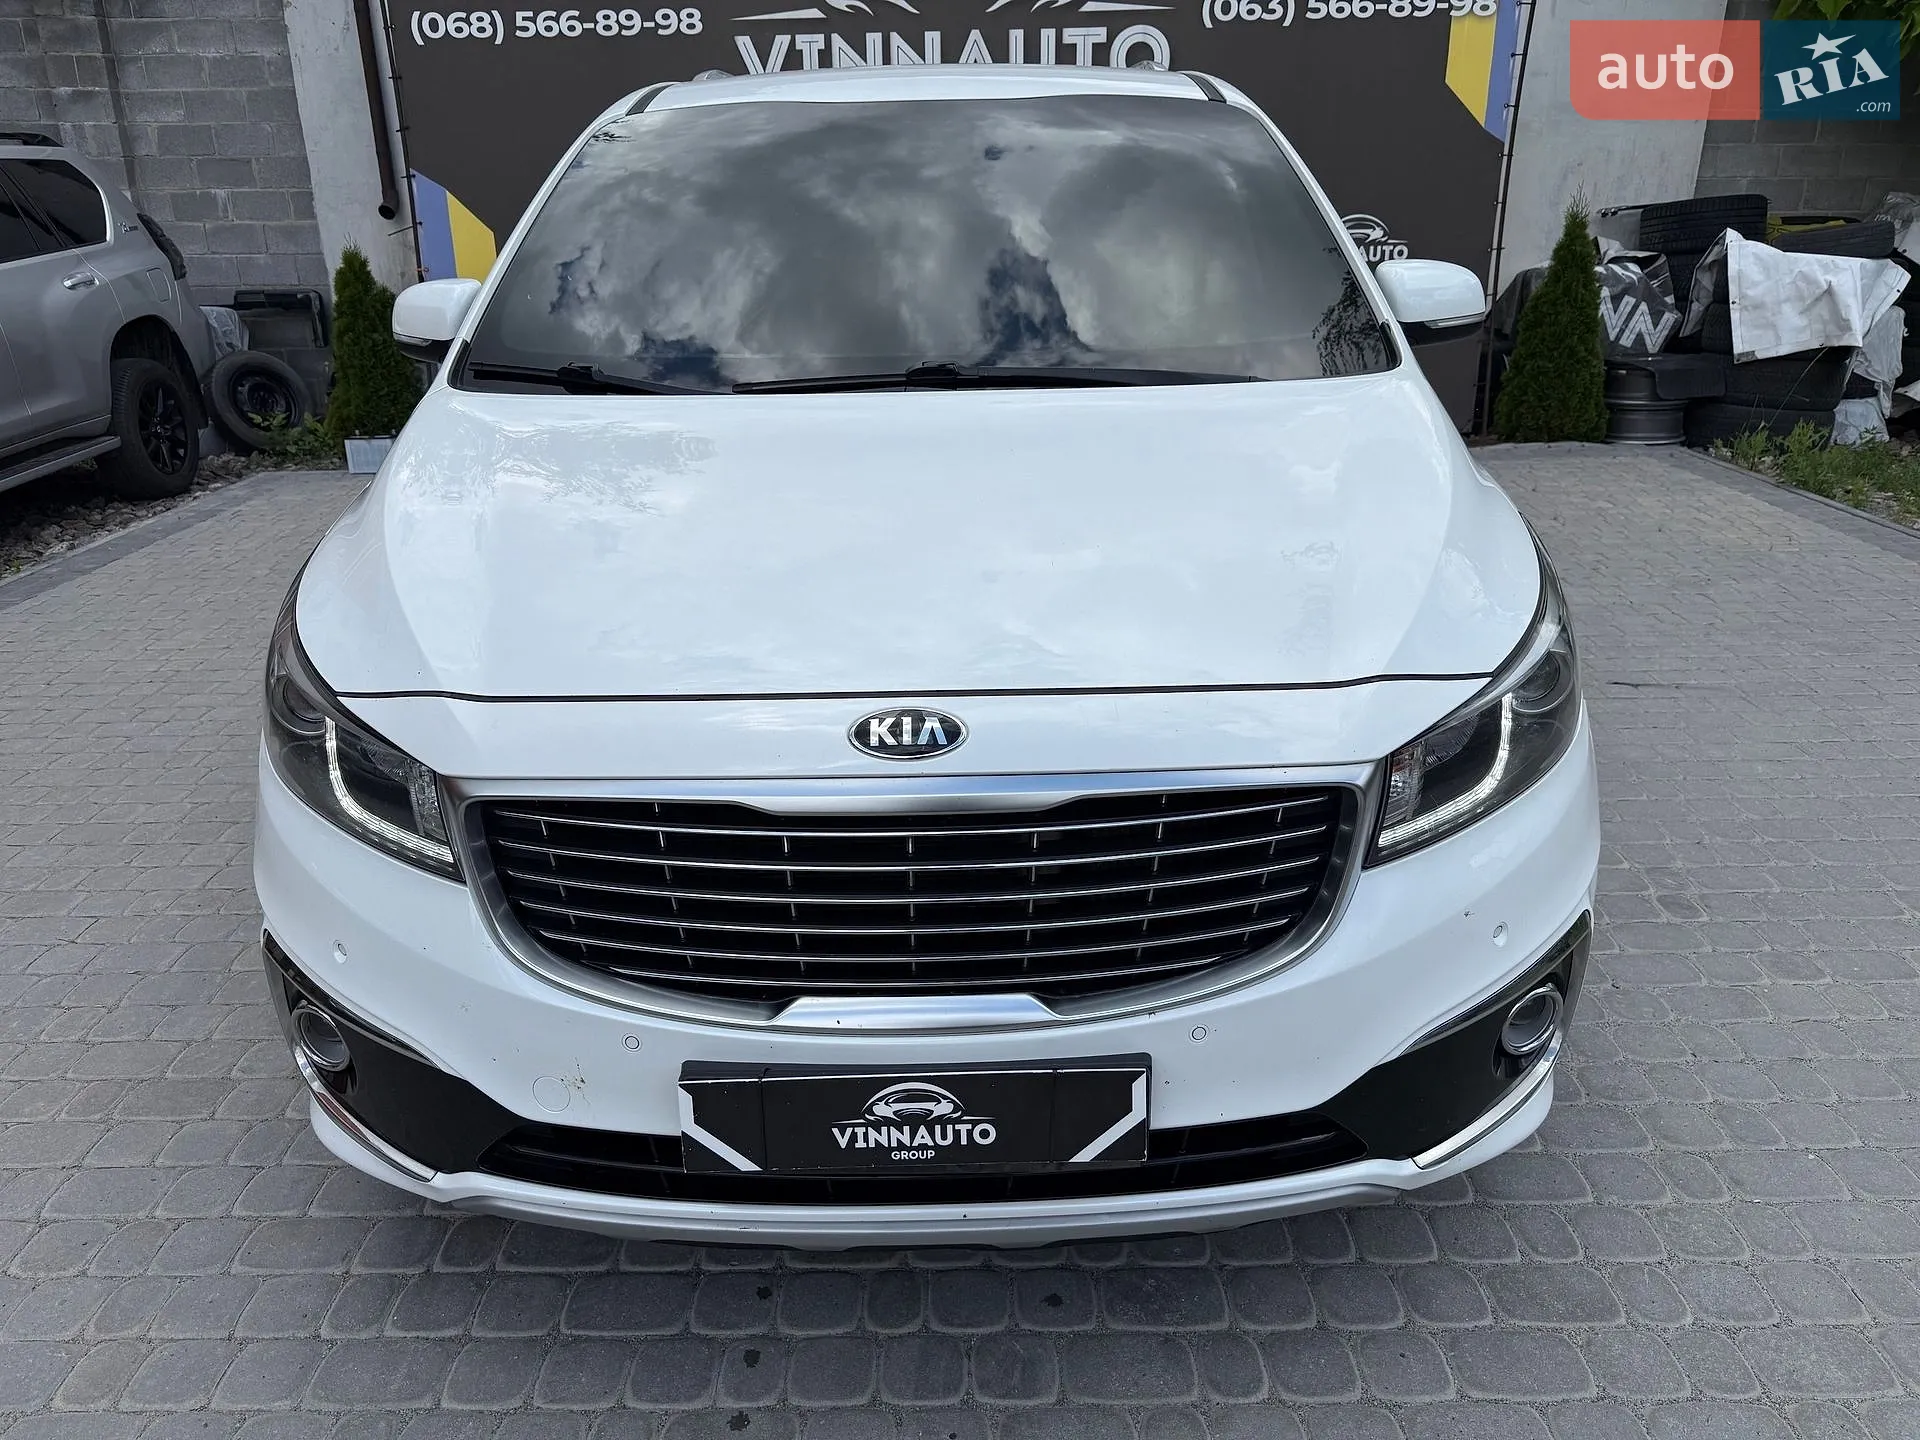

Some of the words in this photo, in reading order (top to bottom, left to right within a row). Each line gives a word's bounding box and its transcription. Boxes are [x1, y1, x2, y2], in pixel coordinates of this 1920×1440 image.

[410, 10, 505, 45] (068)
[514, 8, 703, 38] 566-89-98
[1202, 0, 1296, 28] (063)
[868, 716, 948, 747] KIA
[831, 1123, 997, 1149] VINNAUTO
[891, 1150, 936, 1160] GROUP
